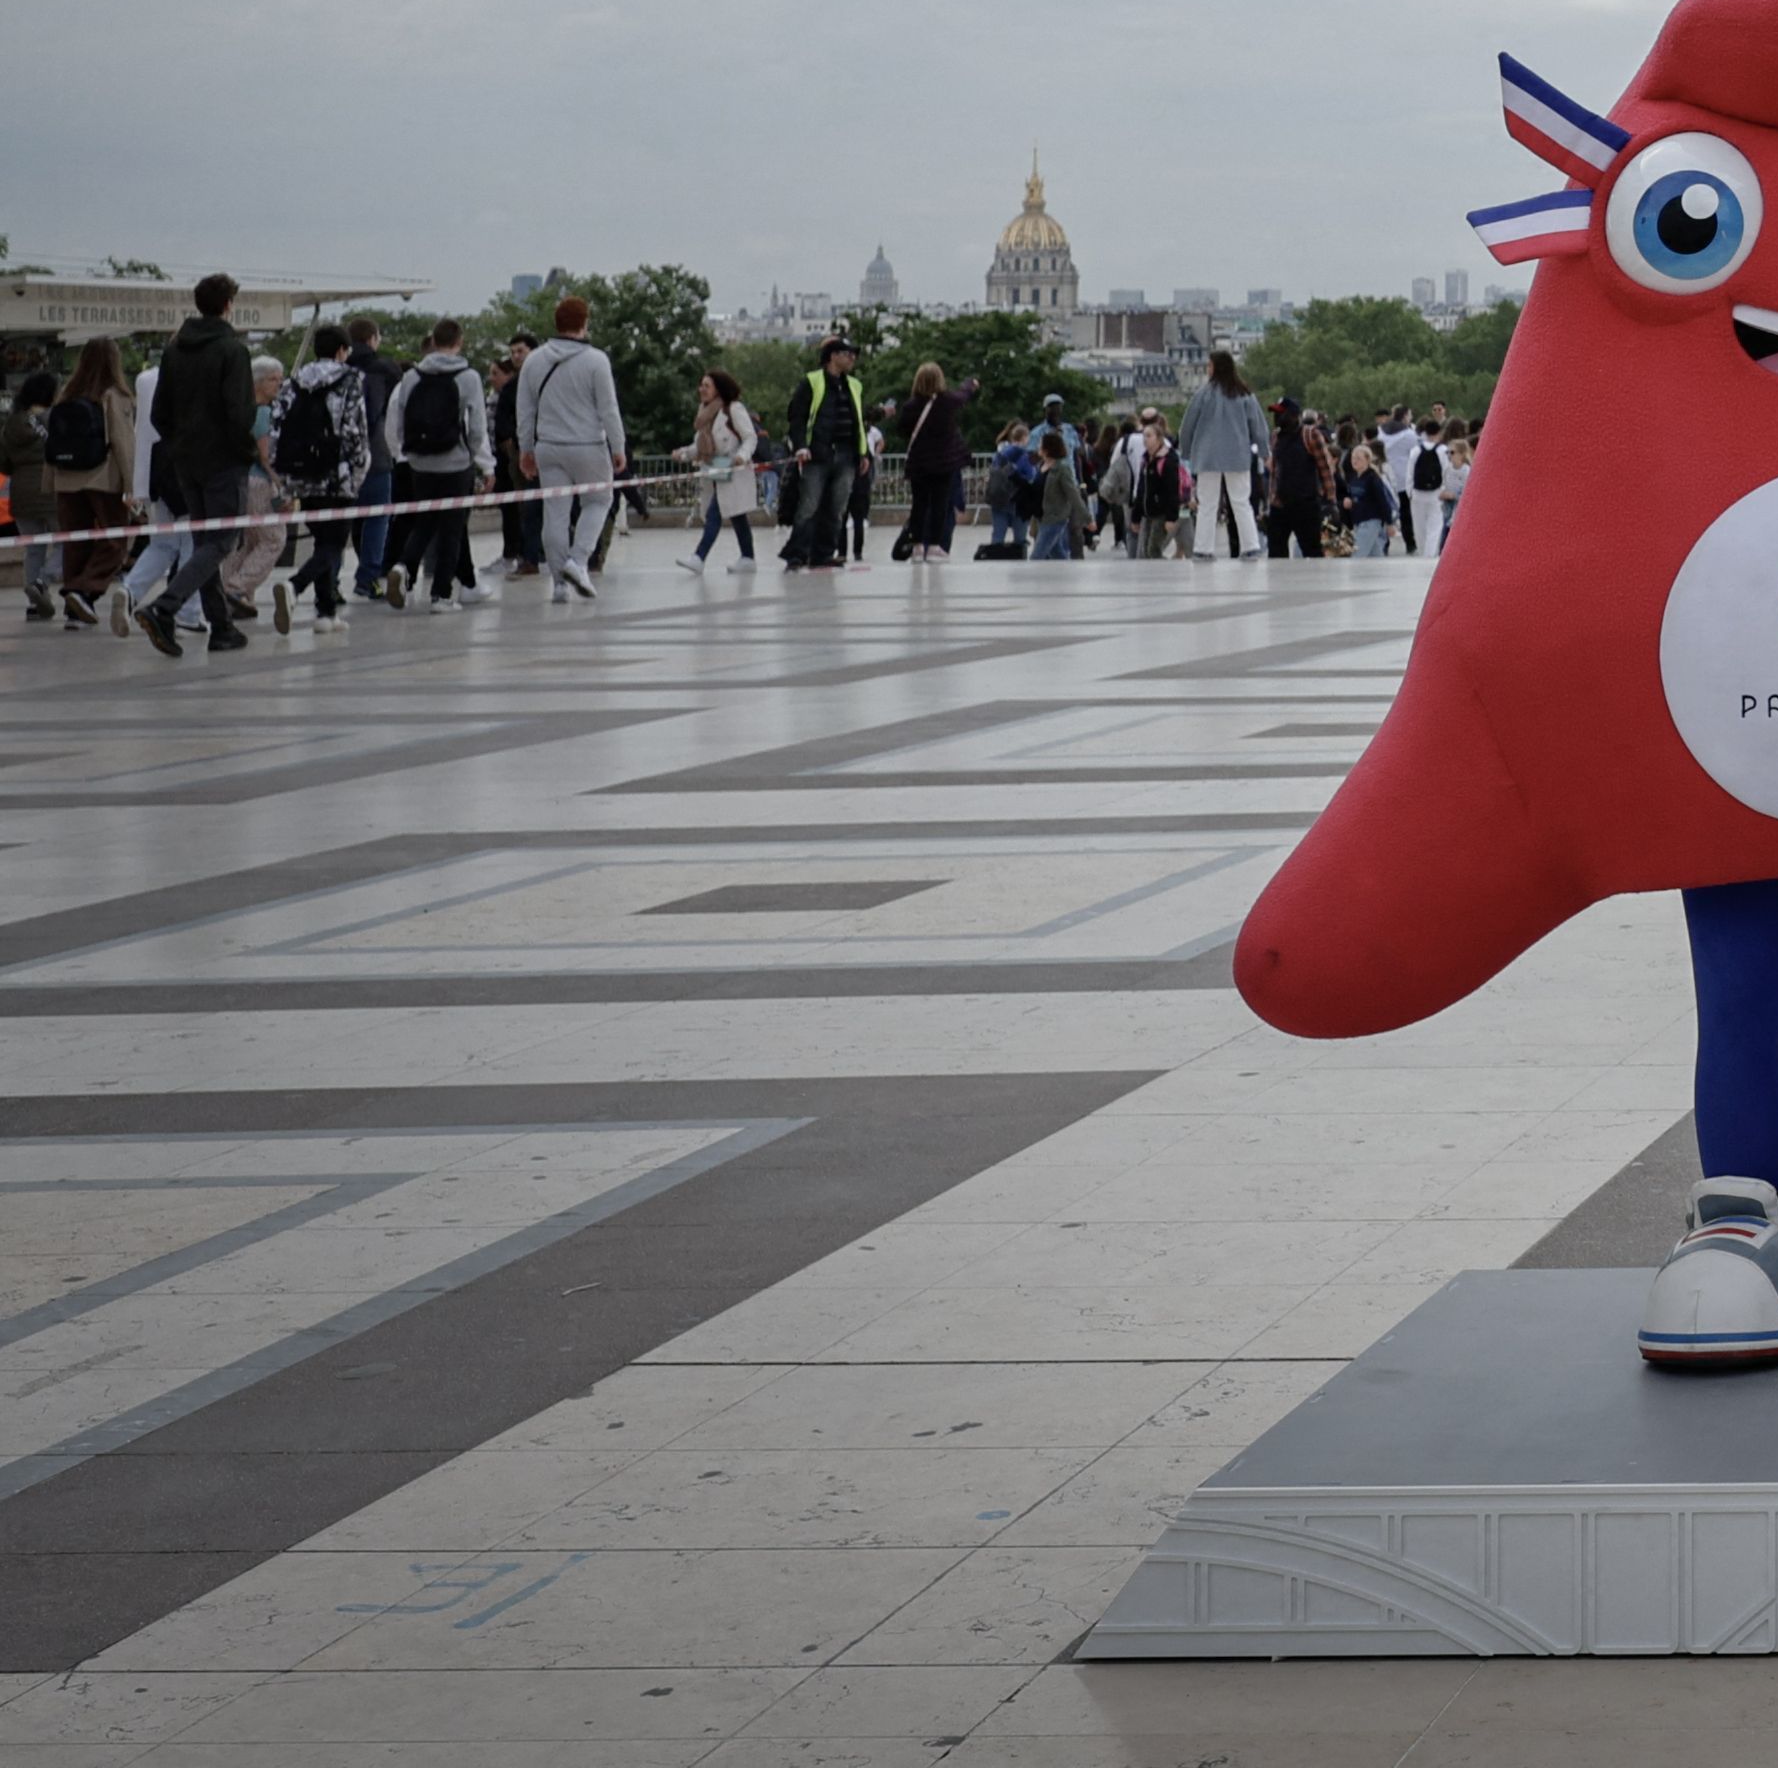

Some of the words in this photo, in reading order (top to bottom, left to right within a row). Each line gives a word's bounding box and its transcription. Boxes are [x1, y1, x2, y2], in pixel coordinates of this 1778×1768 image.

[39, 306, 66, 323] LES
[72, 306, 151, 324] TERRASSES
[157, 308, 176, 325] DU
